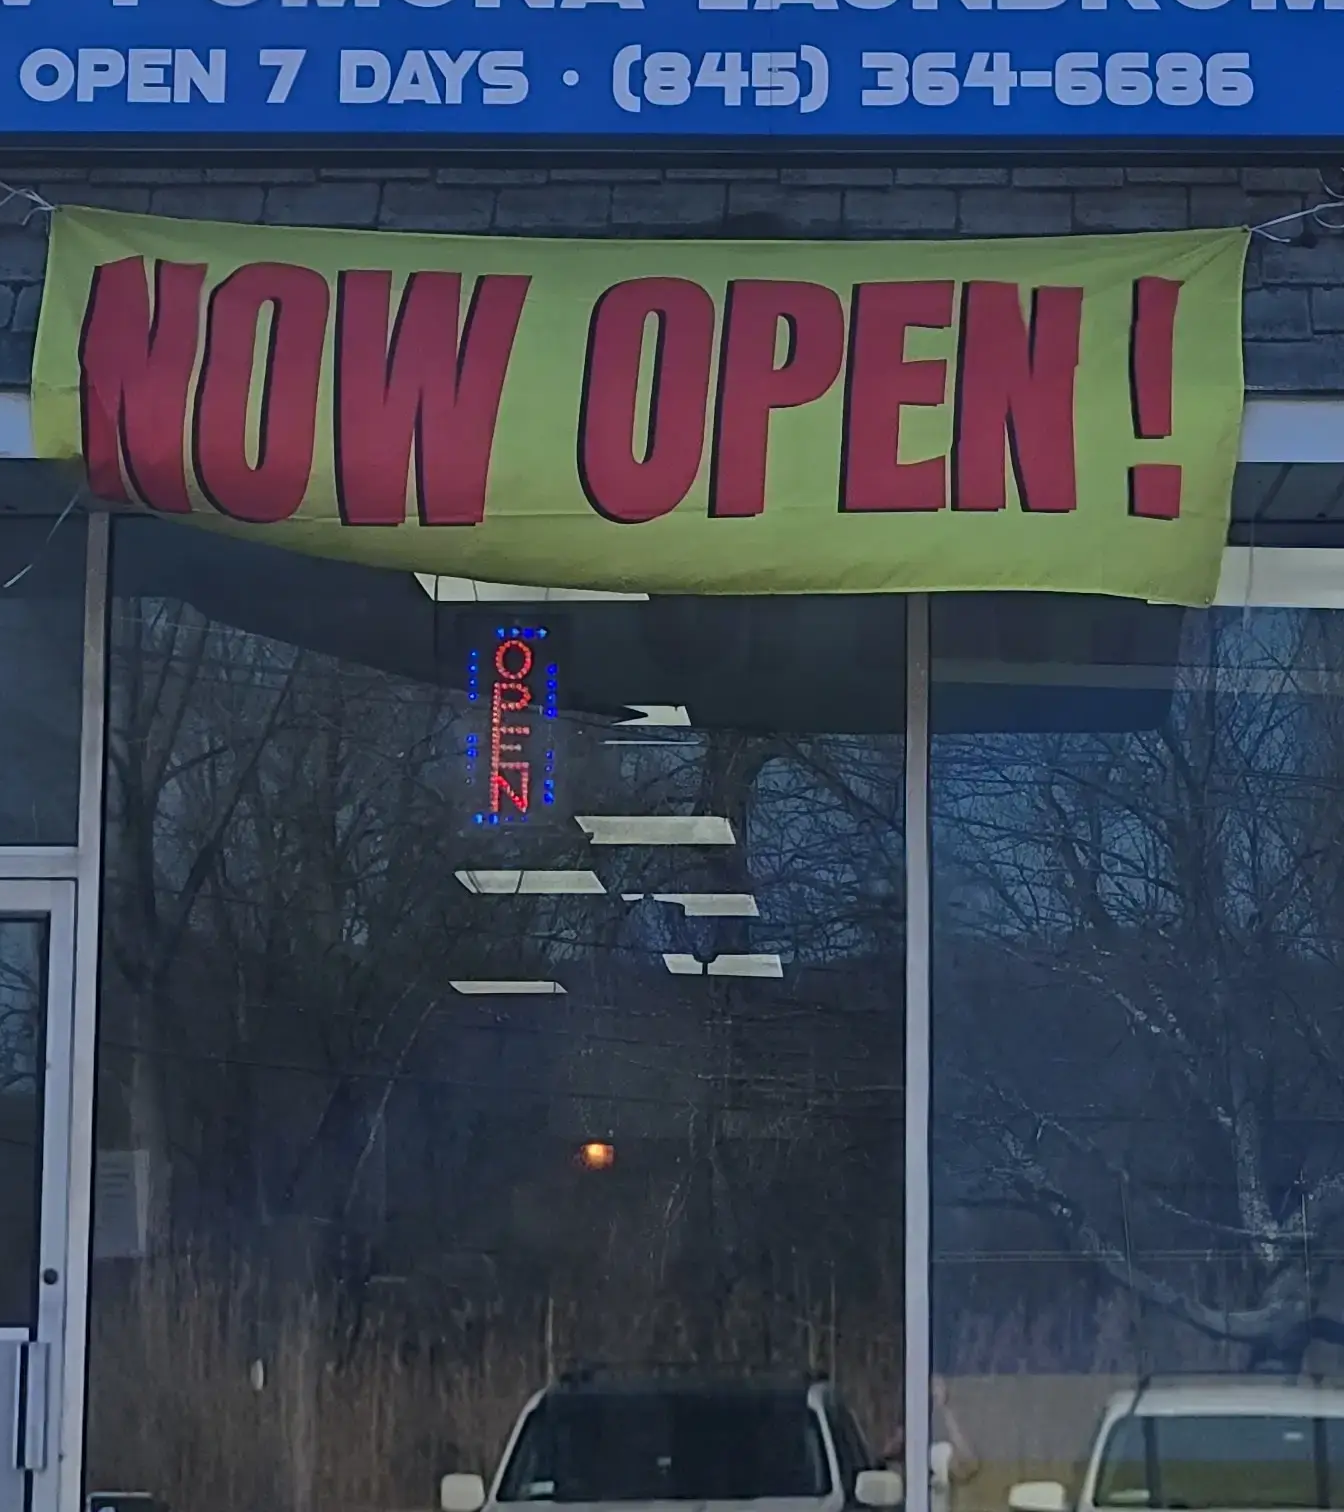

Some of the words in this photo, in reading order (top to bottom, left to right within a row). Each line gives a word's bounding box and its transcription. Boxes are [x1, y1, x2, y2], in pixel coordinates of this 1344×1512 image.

[18, 47, 227, 105] OPEN
[258, 49, 308, 105] 7
[338, 49, 529, 107] DAYS
[611, 43, 830, 114] (845)
[861, 51, 1255, 107] 364-6686
[79, 254, 532, 526] NOW
[490, 639, 533, 813] OPEN
